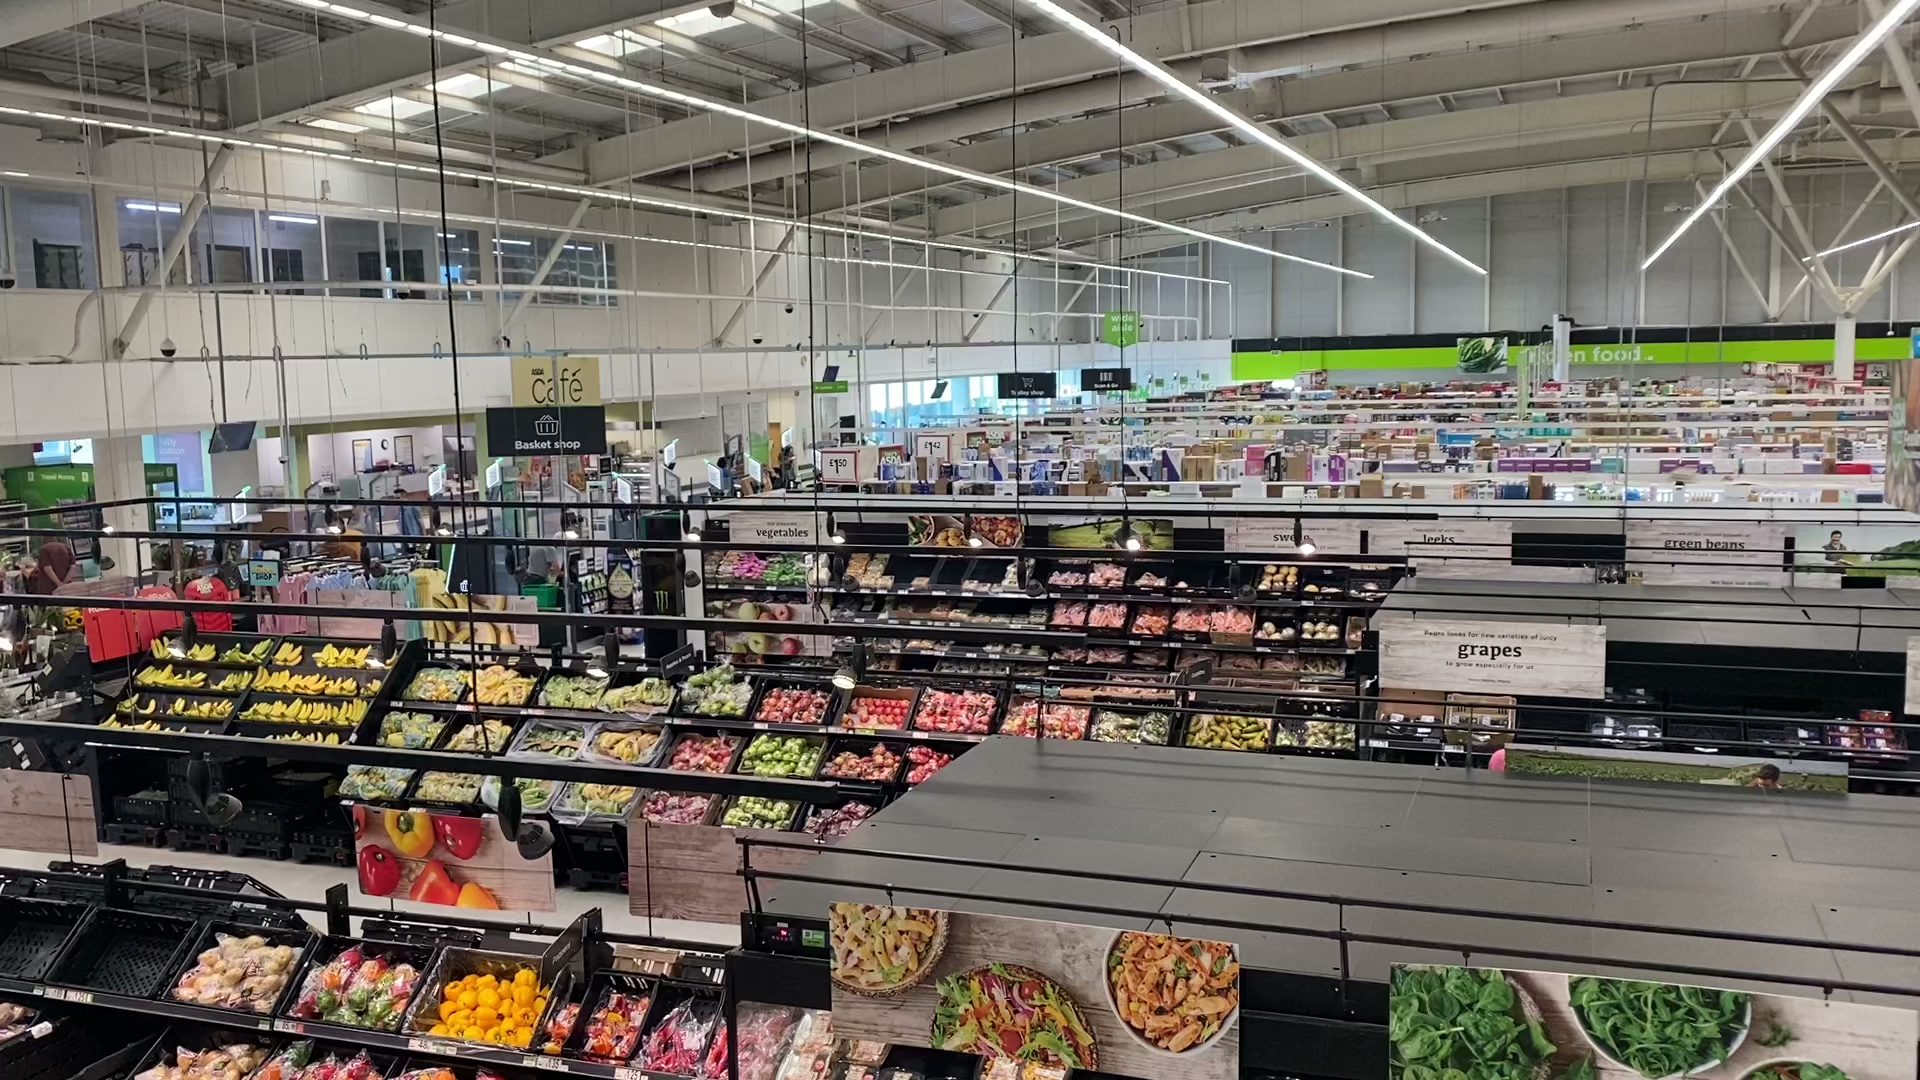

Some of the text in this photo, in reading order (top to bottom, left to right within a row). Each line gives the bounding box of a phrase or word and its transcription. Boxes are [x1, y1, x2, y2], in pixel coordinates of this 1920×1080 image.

[1592, 346, 1641, 362] food
[531, 368, 545, 376] ASDA
[515, 440, 581, 451] Basket shop
[756, 527, 808, 539] vegetables
[1422, 534, 1456, 544] leeks
[1664, 538, 1746, 550] green beans
[1458, 644, 1522, 660] grapes
